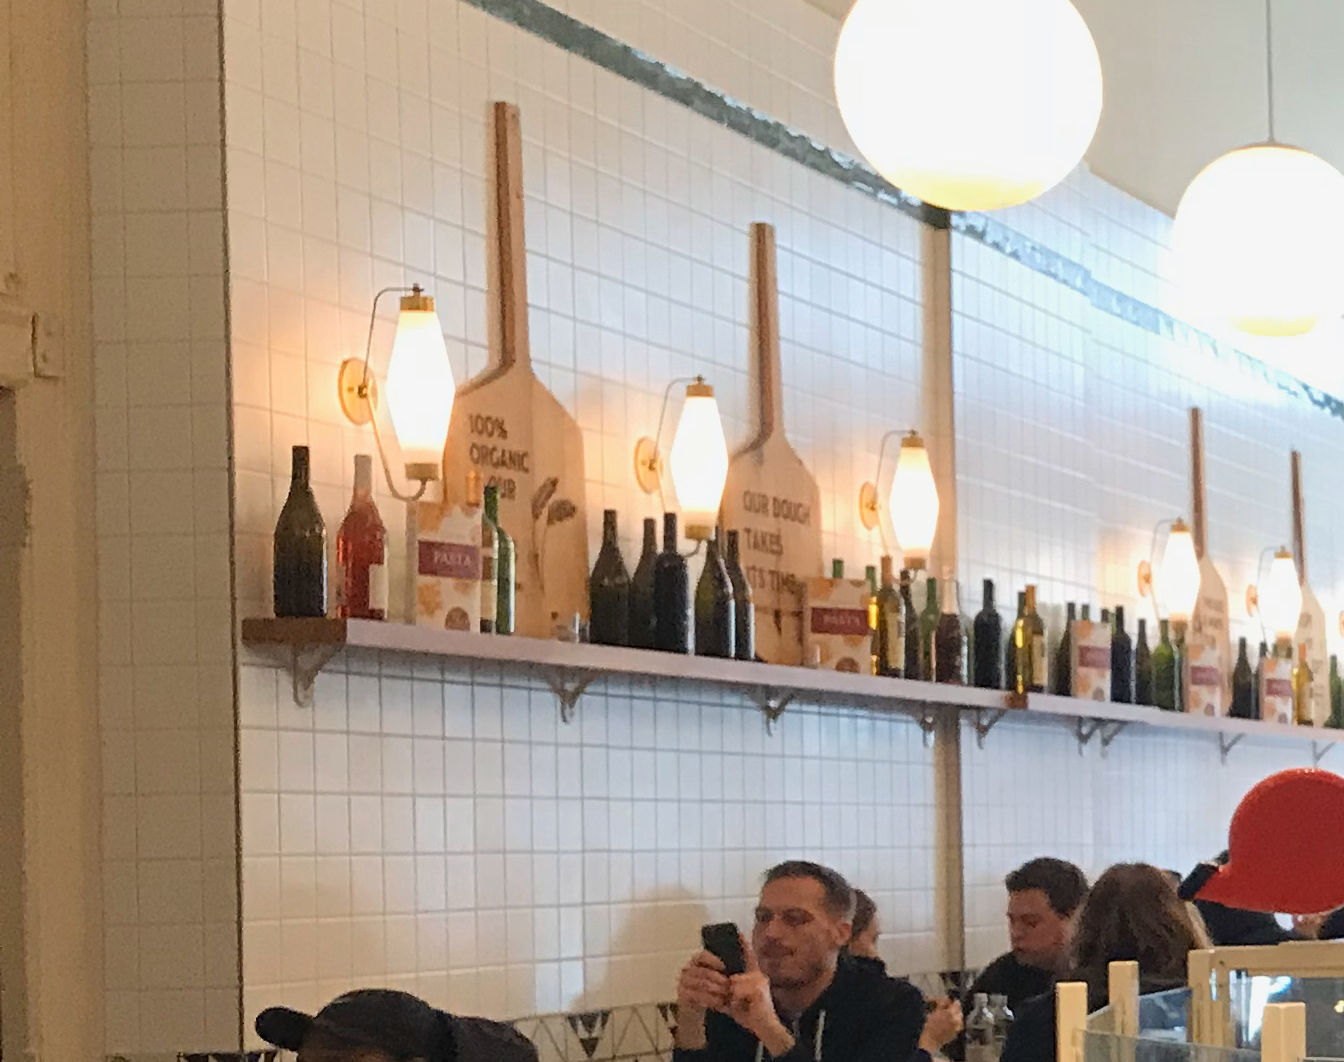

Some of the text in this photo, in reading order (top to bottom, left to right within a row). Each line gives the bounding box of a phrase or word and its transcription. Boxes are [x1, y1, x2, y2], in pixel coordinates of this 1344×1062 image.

[469, 414, 508, 440] 100%
[470, 443, 530, 474] ORGANIC
[744, 490, 811, 526] OUR DOUGH
[744, 527, 783, 556] TAKES
